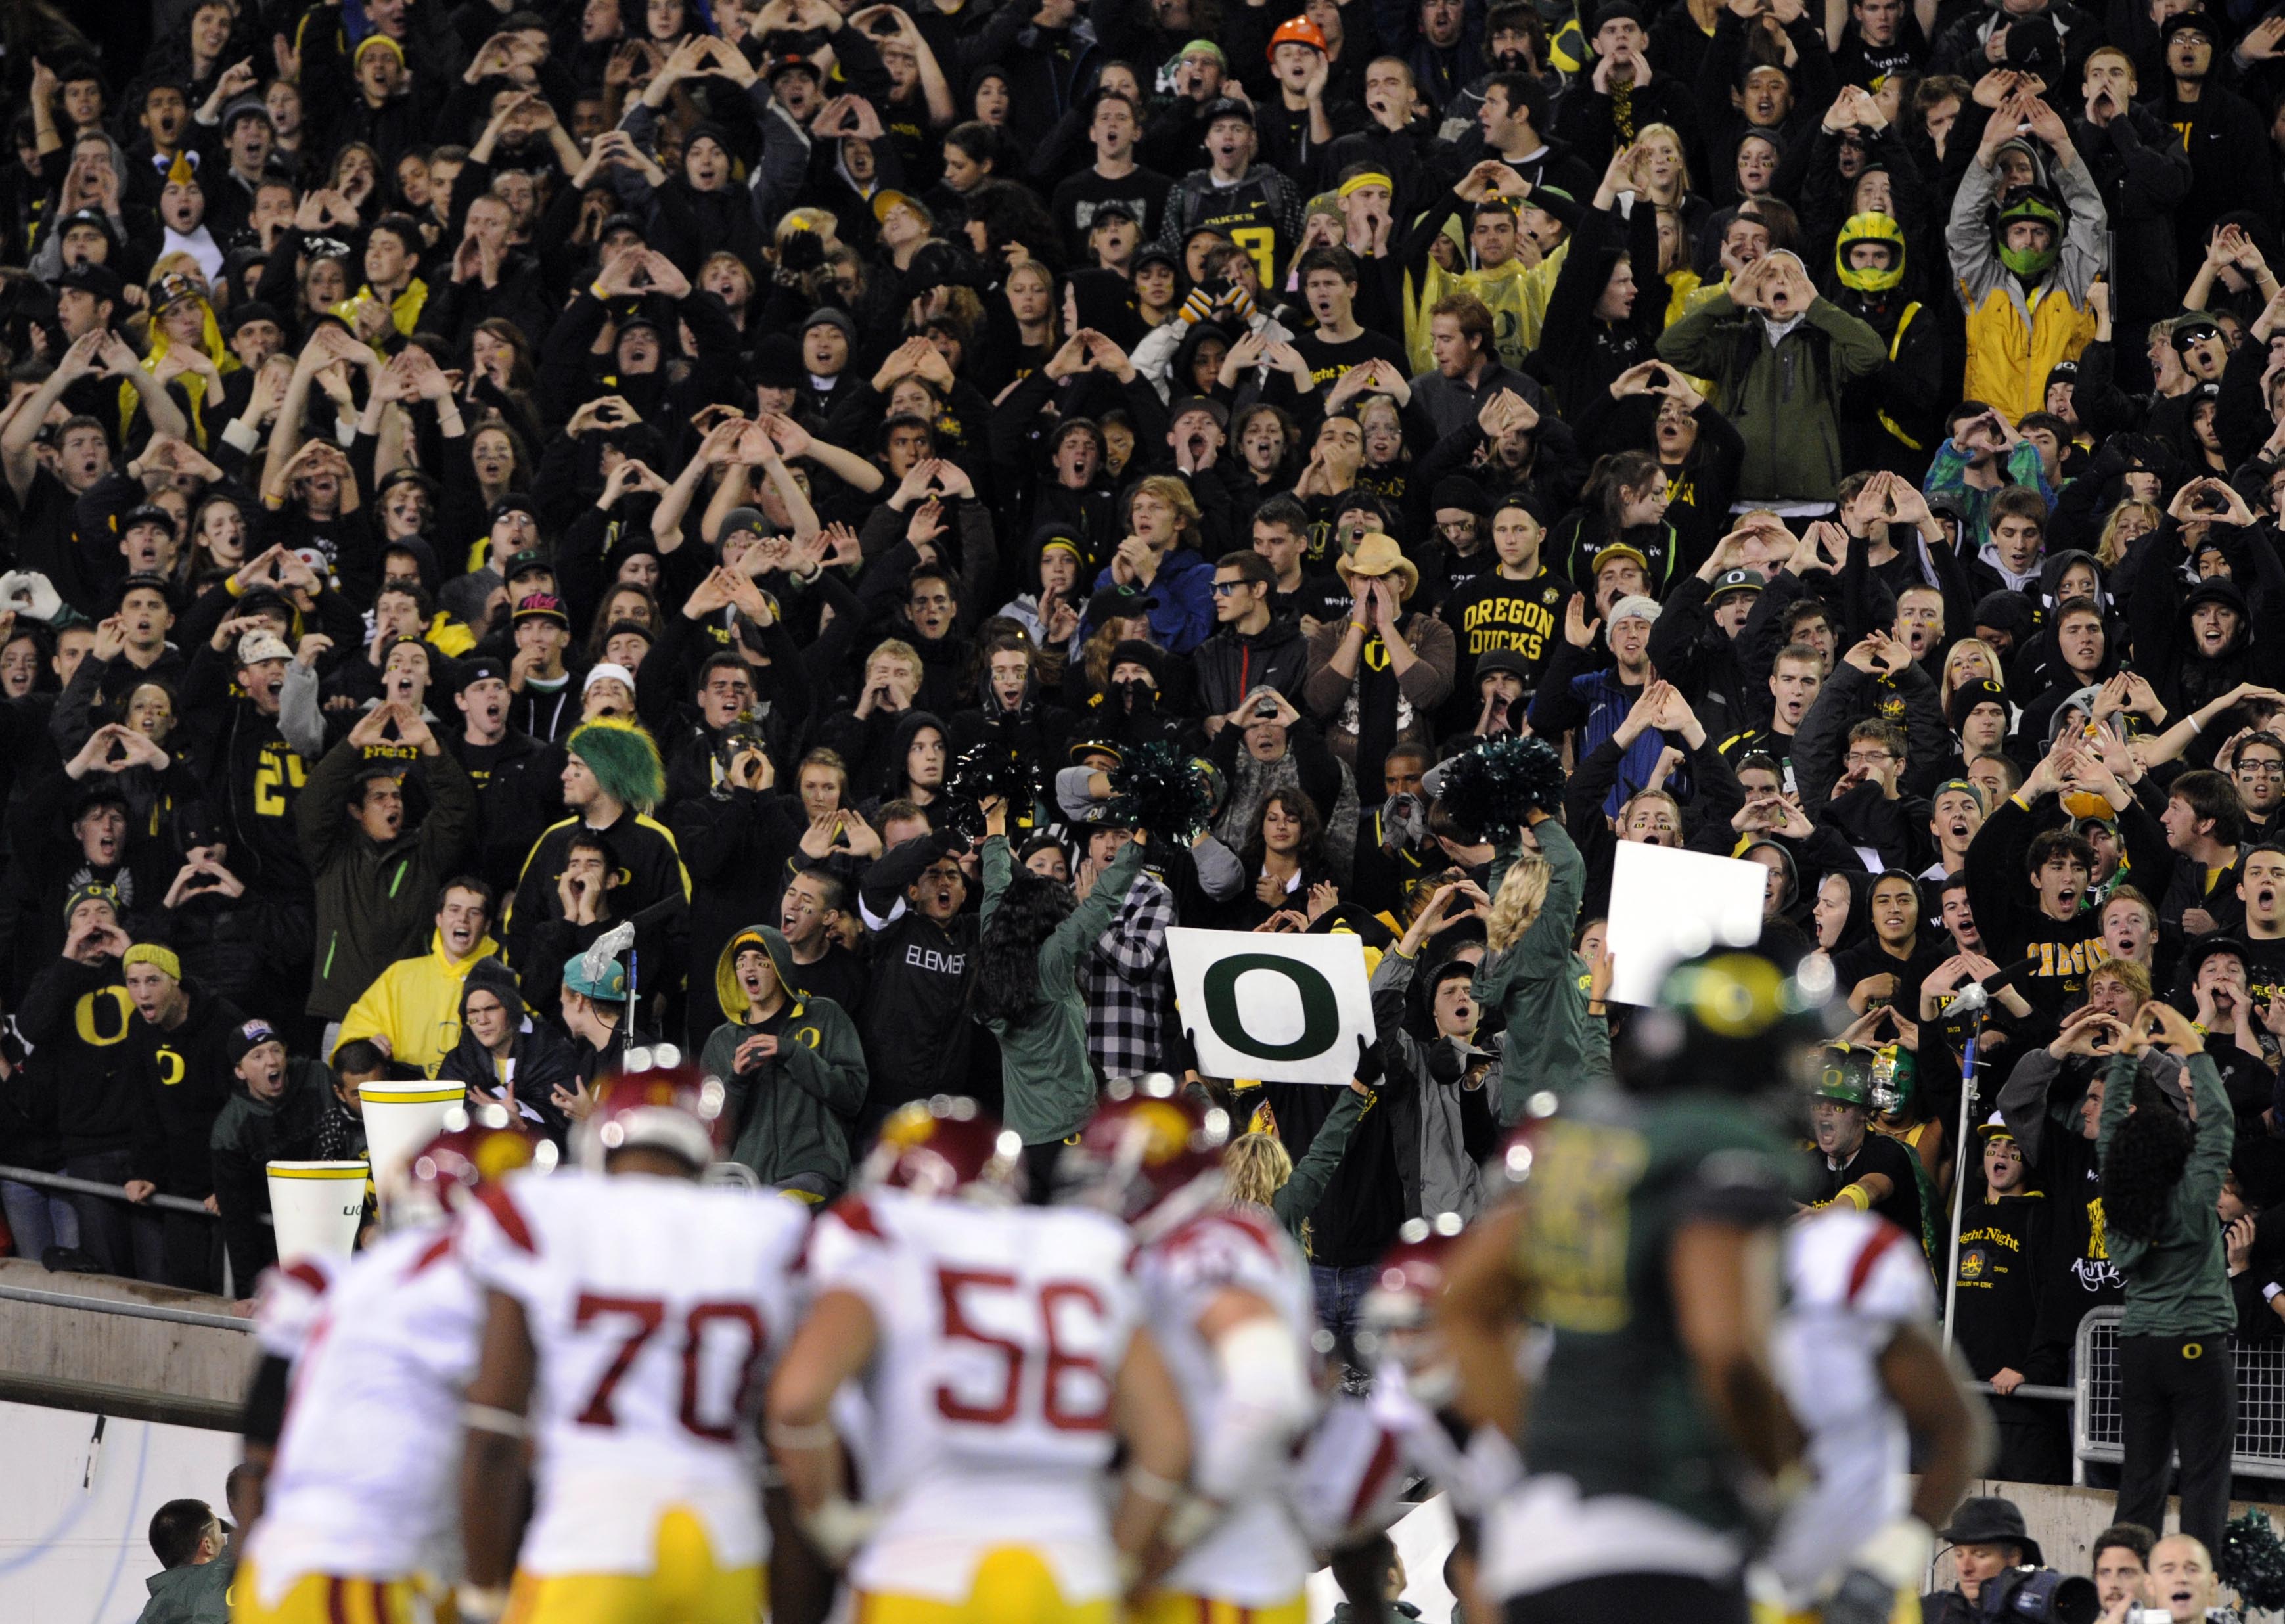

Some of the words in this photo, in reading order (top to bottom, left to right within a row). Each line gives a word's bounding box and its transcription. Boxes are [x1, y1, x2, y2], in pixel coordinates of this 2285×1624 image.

[1727, 570, 1746, 583] O
[1464, 597, 1555, 640] OREGON
[1468, 630, 1542, 660] DUCKS
[1983, 680, 2001, 692] O
[76, 985, 138, 1047] O
[1204, 954, 1339, 1062] O
[572, 1292, 767, 1442] 70
[936, 1268, 1118, 1431] 56
[2181, 1342, 2202, 1359] O
